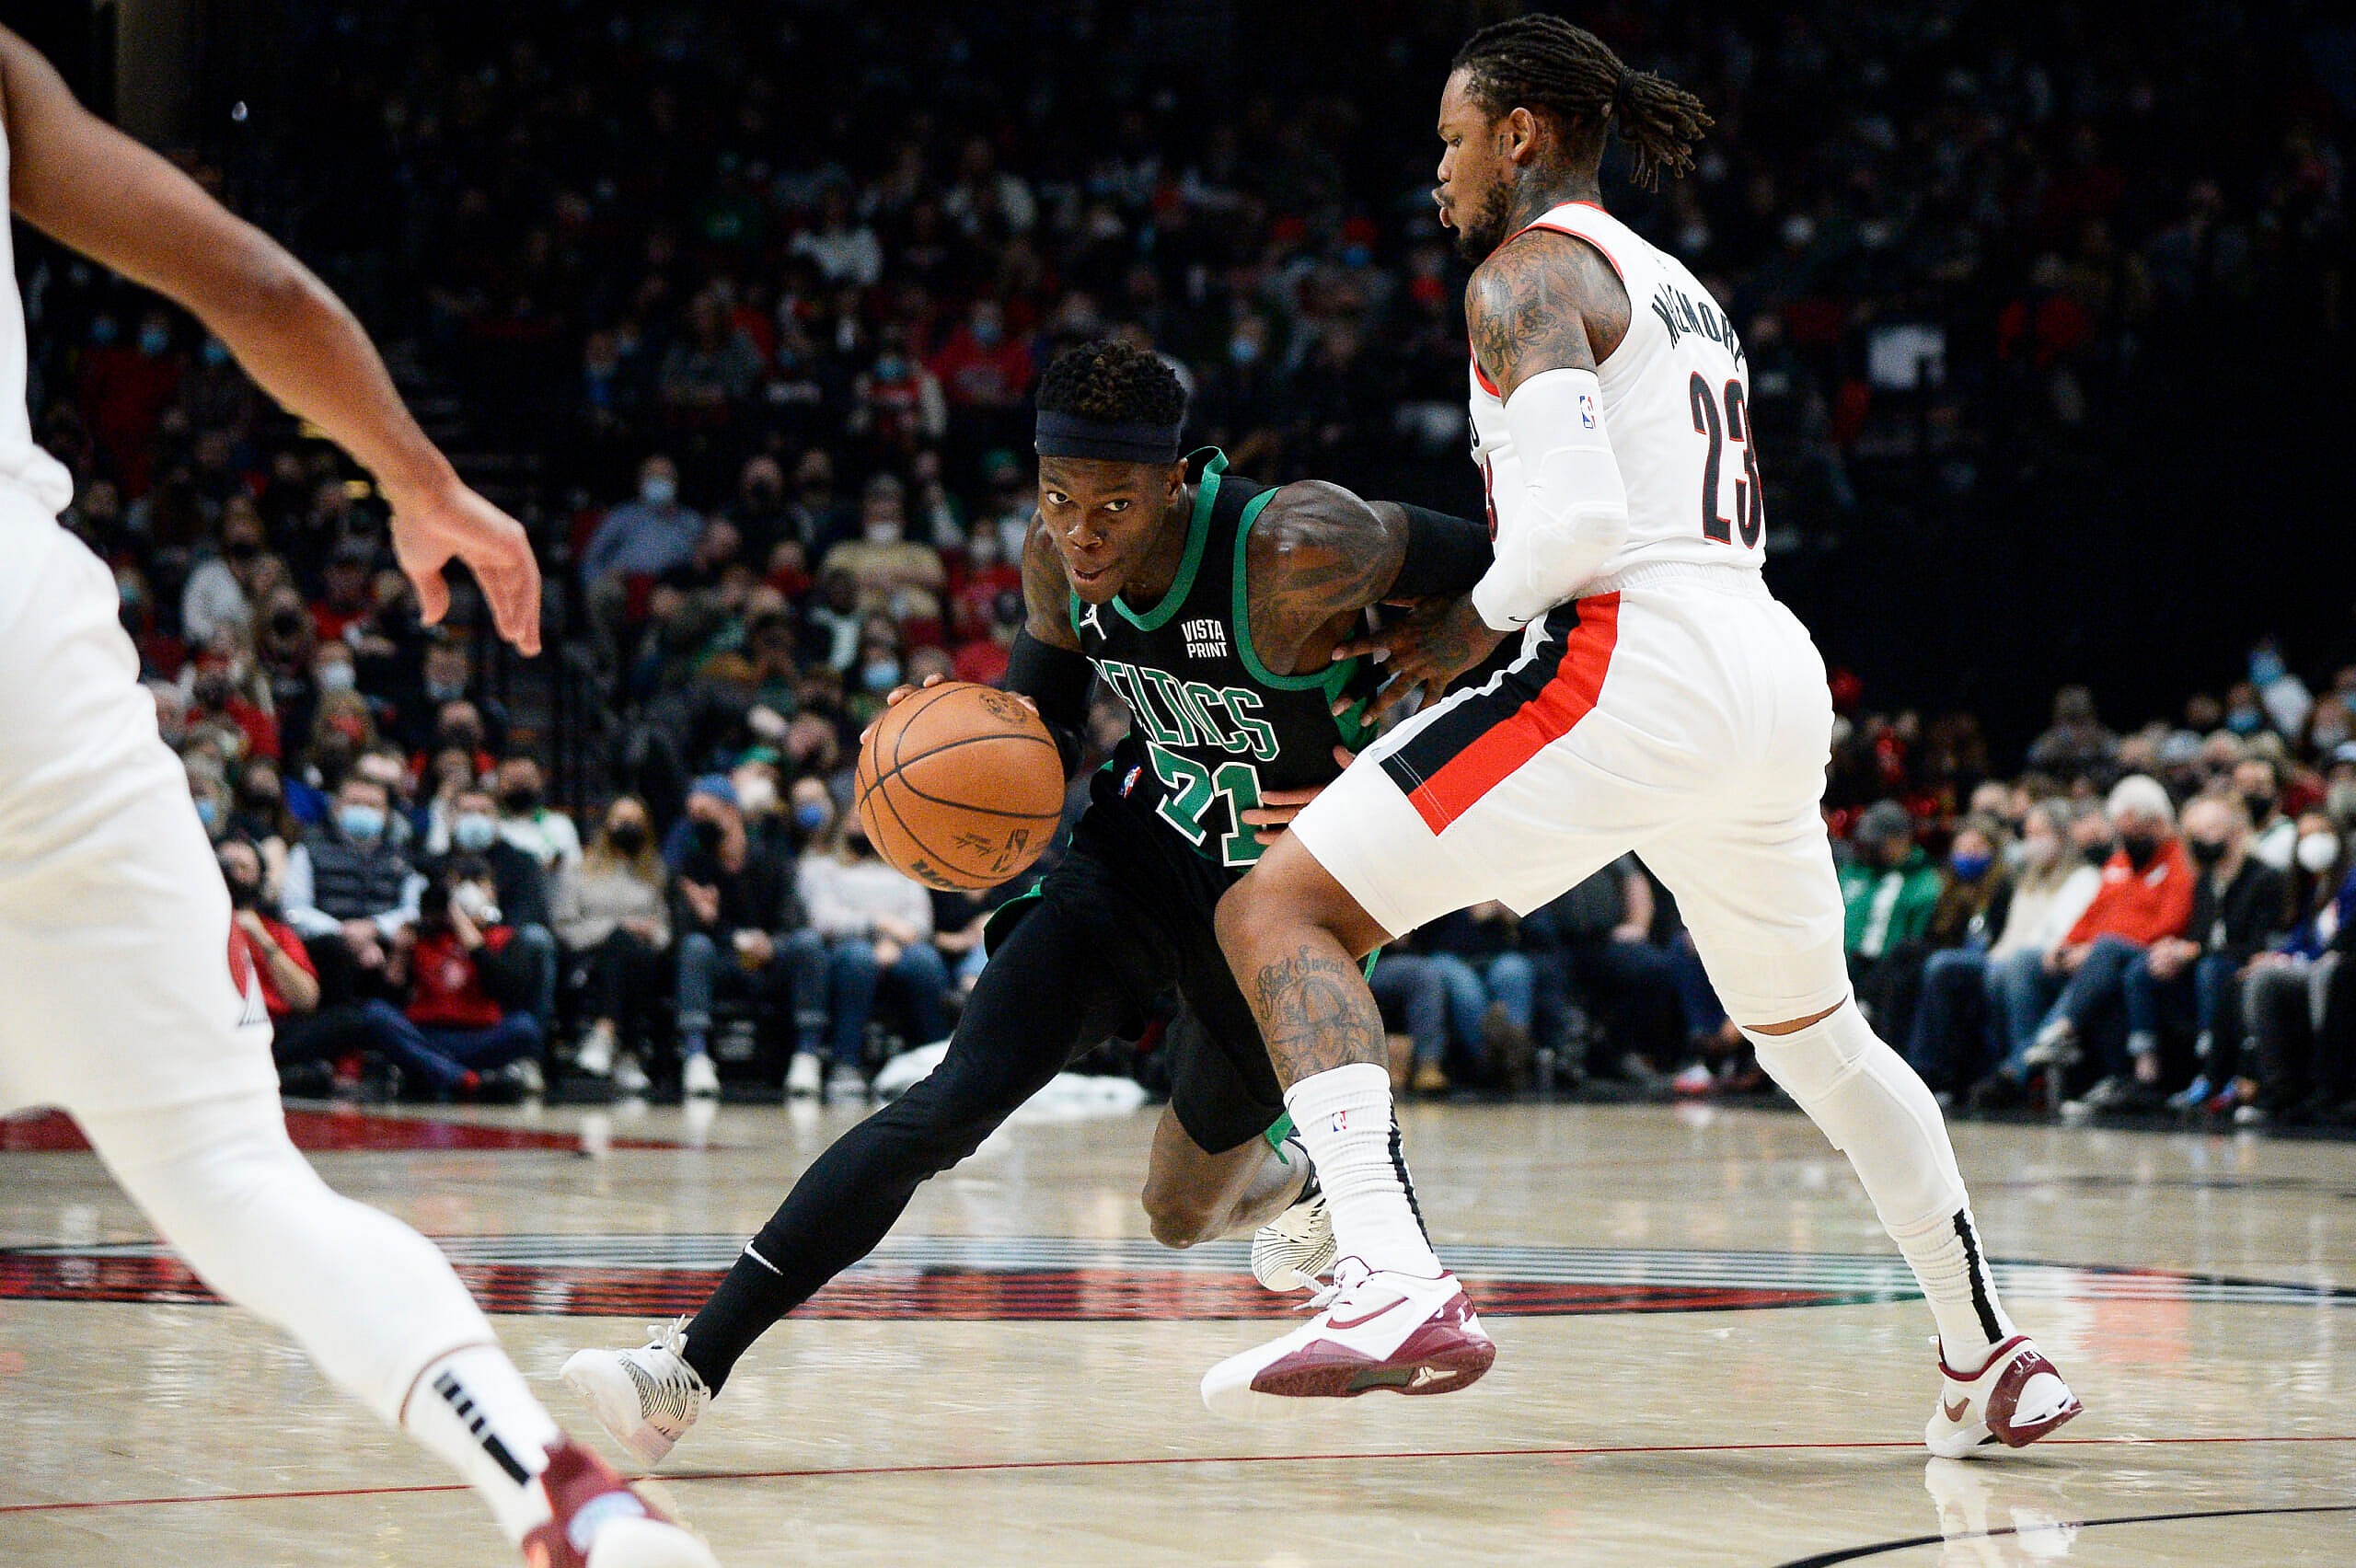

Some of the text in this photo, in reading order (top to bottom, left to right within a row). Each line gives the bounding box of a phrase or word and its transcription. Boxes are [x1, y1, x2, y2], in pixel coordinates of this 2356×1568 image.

[1690, 371, 1762, 549] 23
[1181, 619, 1225, 642] VISTA
[1186, 642, 1228, 659] PRINT
[1086, 656, 1280, 762] ELTICS
